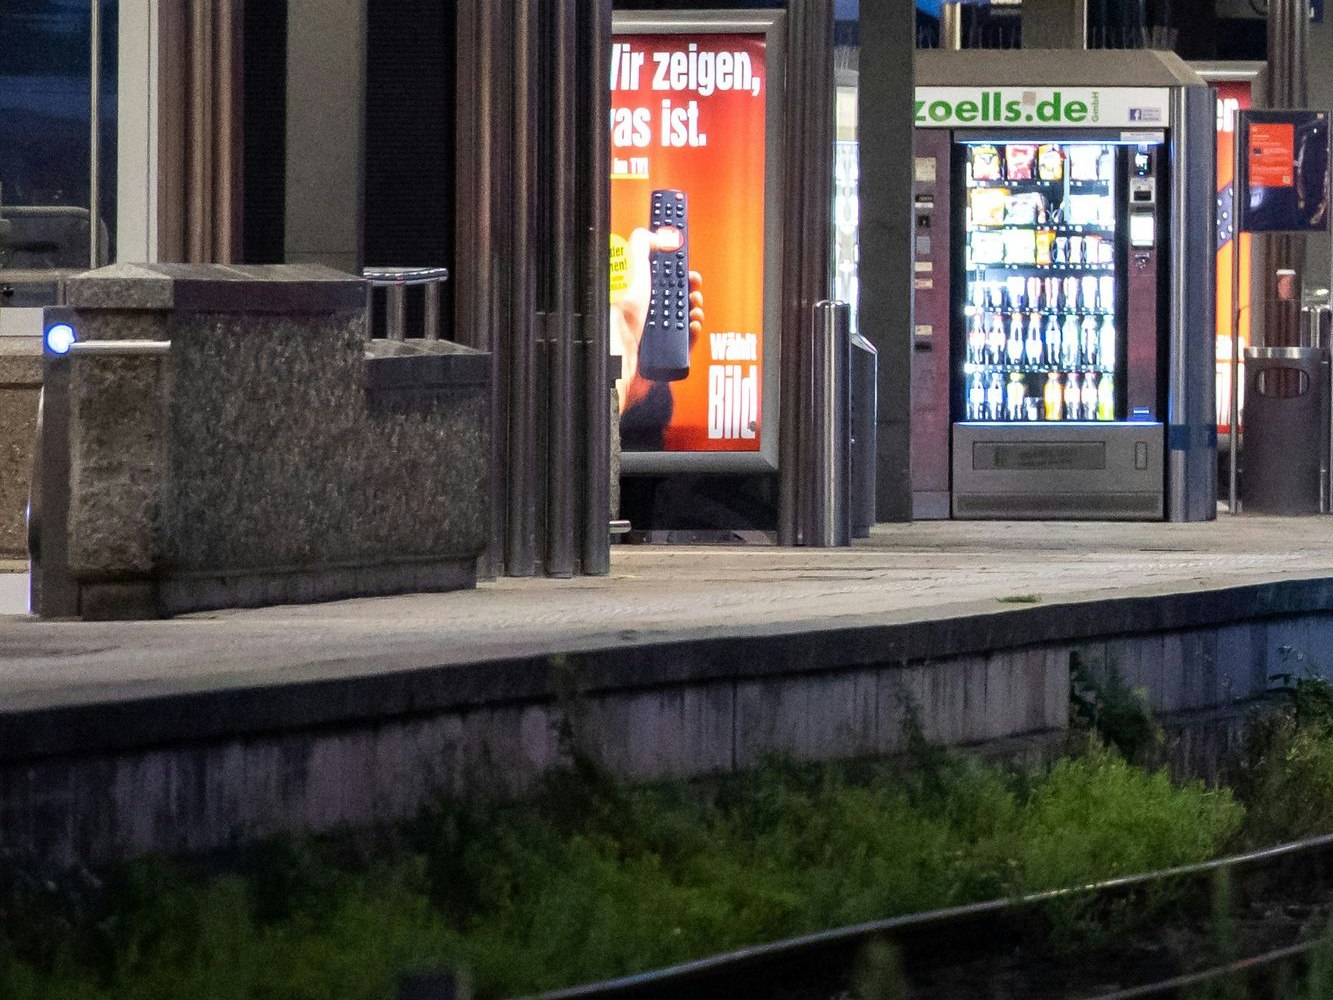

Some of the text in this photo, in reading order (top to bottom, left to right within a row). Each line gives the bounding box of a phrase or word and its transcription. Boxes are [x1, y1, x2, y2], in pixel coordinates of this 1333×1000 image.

[651, 43, 761, 97] zeigen,
[660, 98, 708, 148] ist.
[707, 364, 757, 439] Bild
